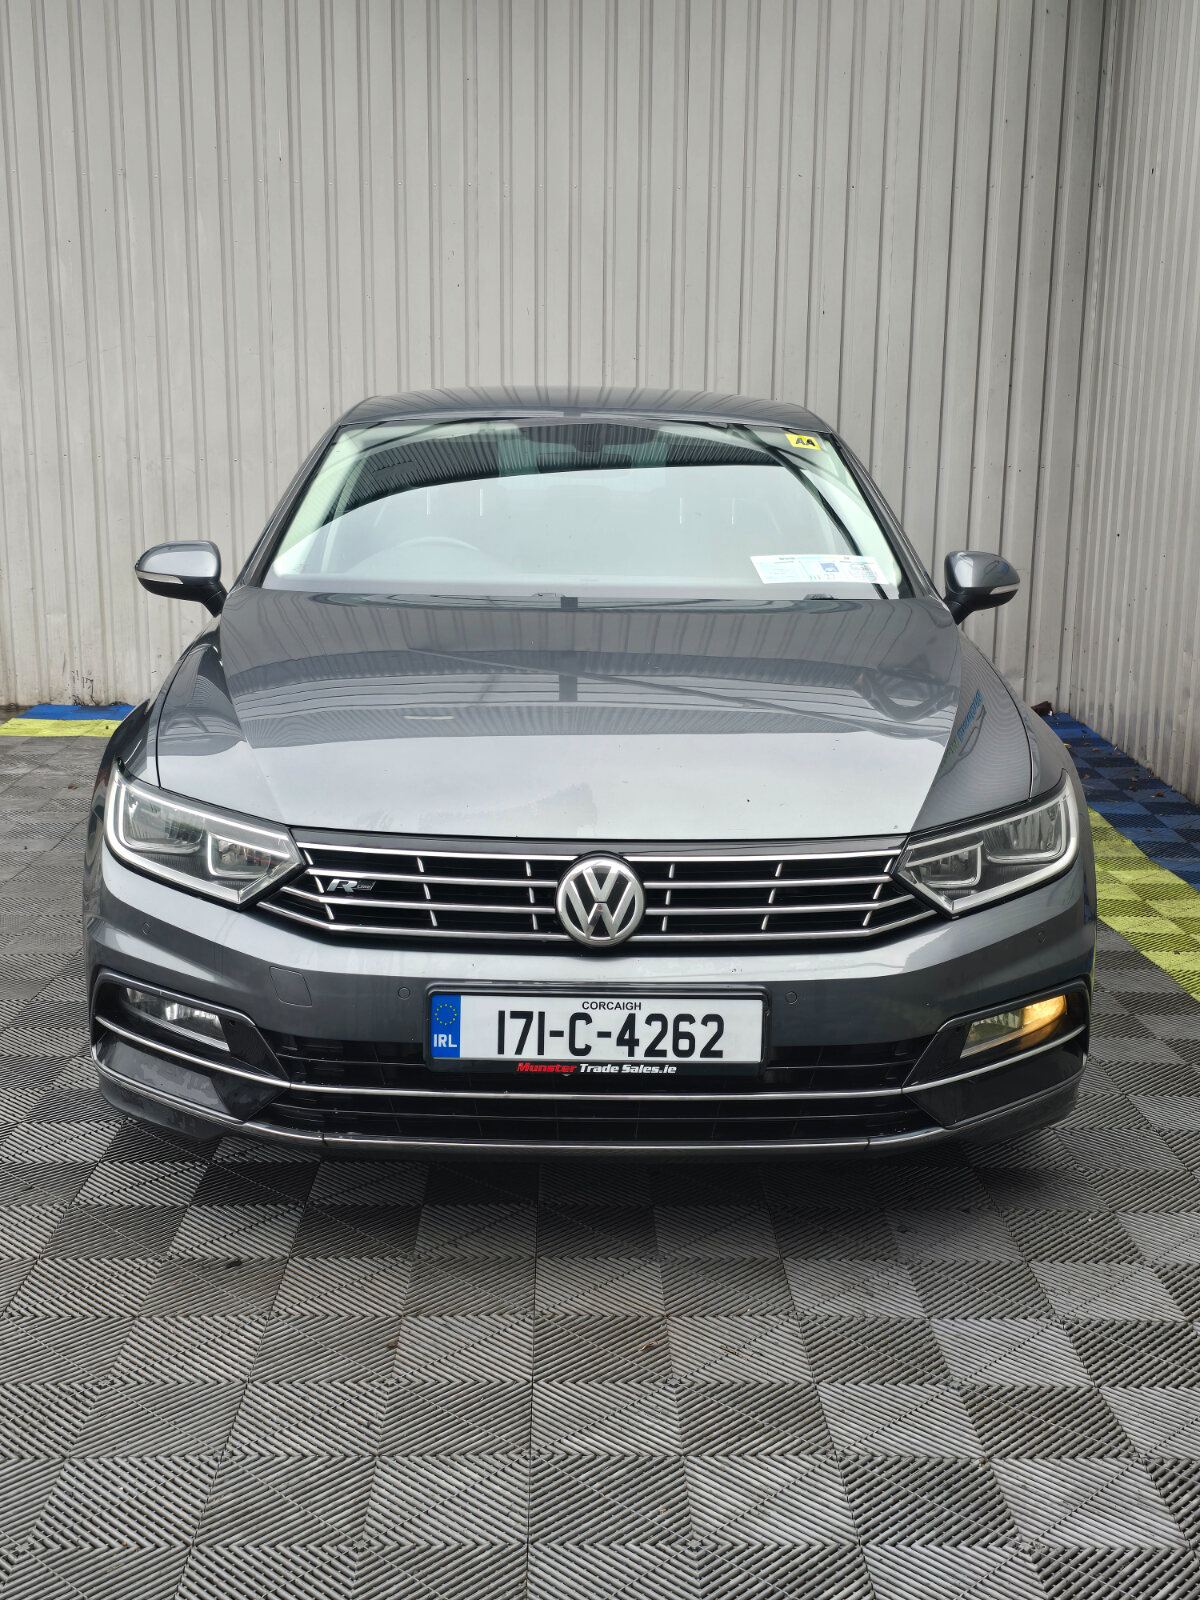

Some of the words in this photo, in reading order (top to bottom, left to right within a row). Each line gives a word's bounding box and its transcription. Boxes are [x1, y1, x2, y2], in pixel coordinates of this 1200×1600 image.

[795, 437, 816, 447] AA
[581, 1001, 642, 1011] CORCAIGH
[497, 1010, 725, 1058] 171-C-4262
[433, 1033, 458, 1048] IRL
[516, 1062, 577, 1073] Munster
[579, 1063, 619, 1073] Trade
[621, 1064, 677, 1074] Sales.ie
